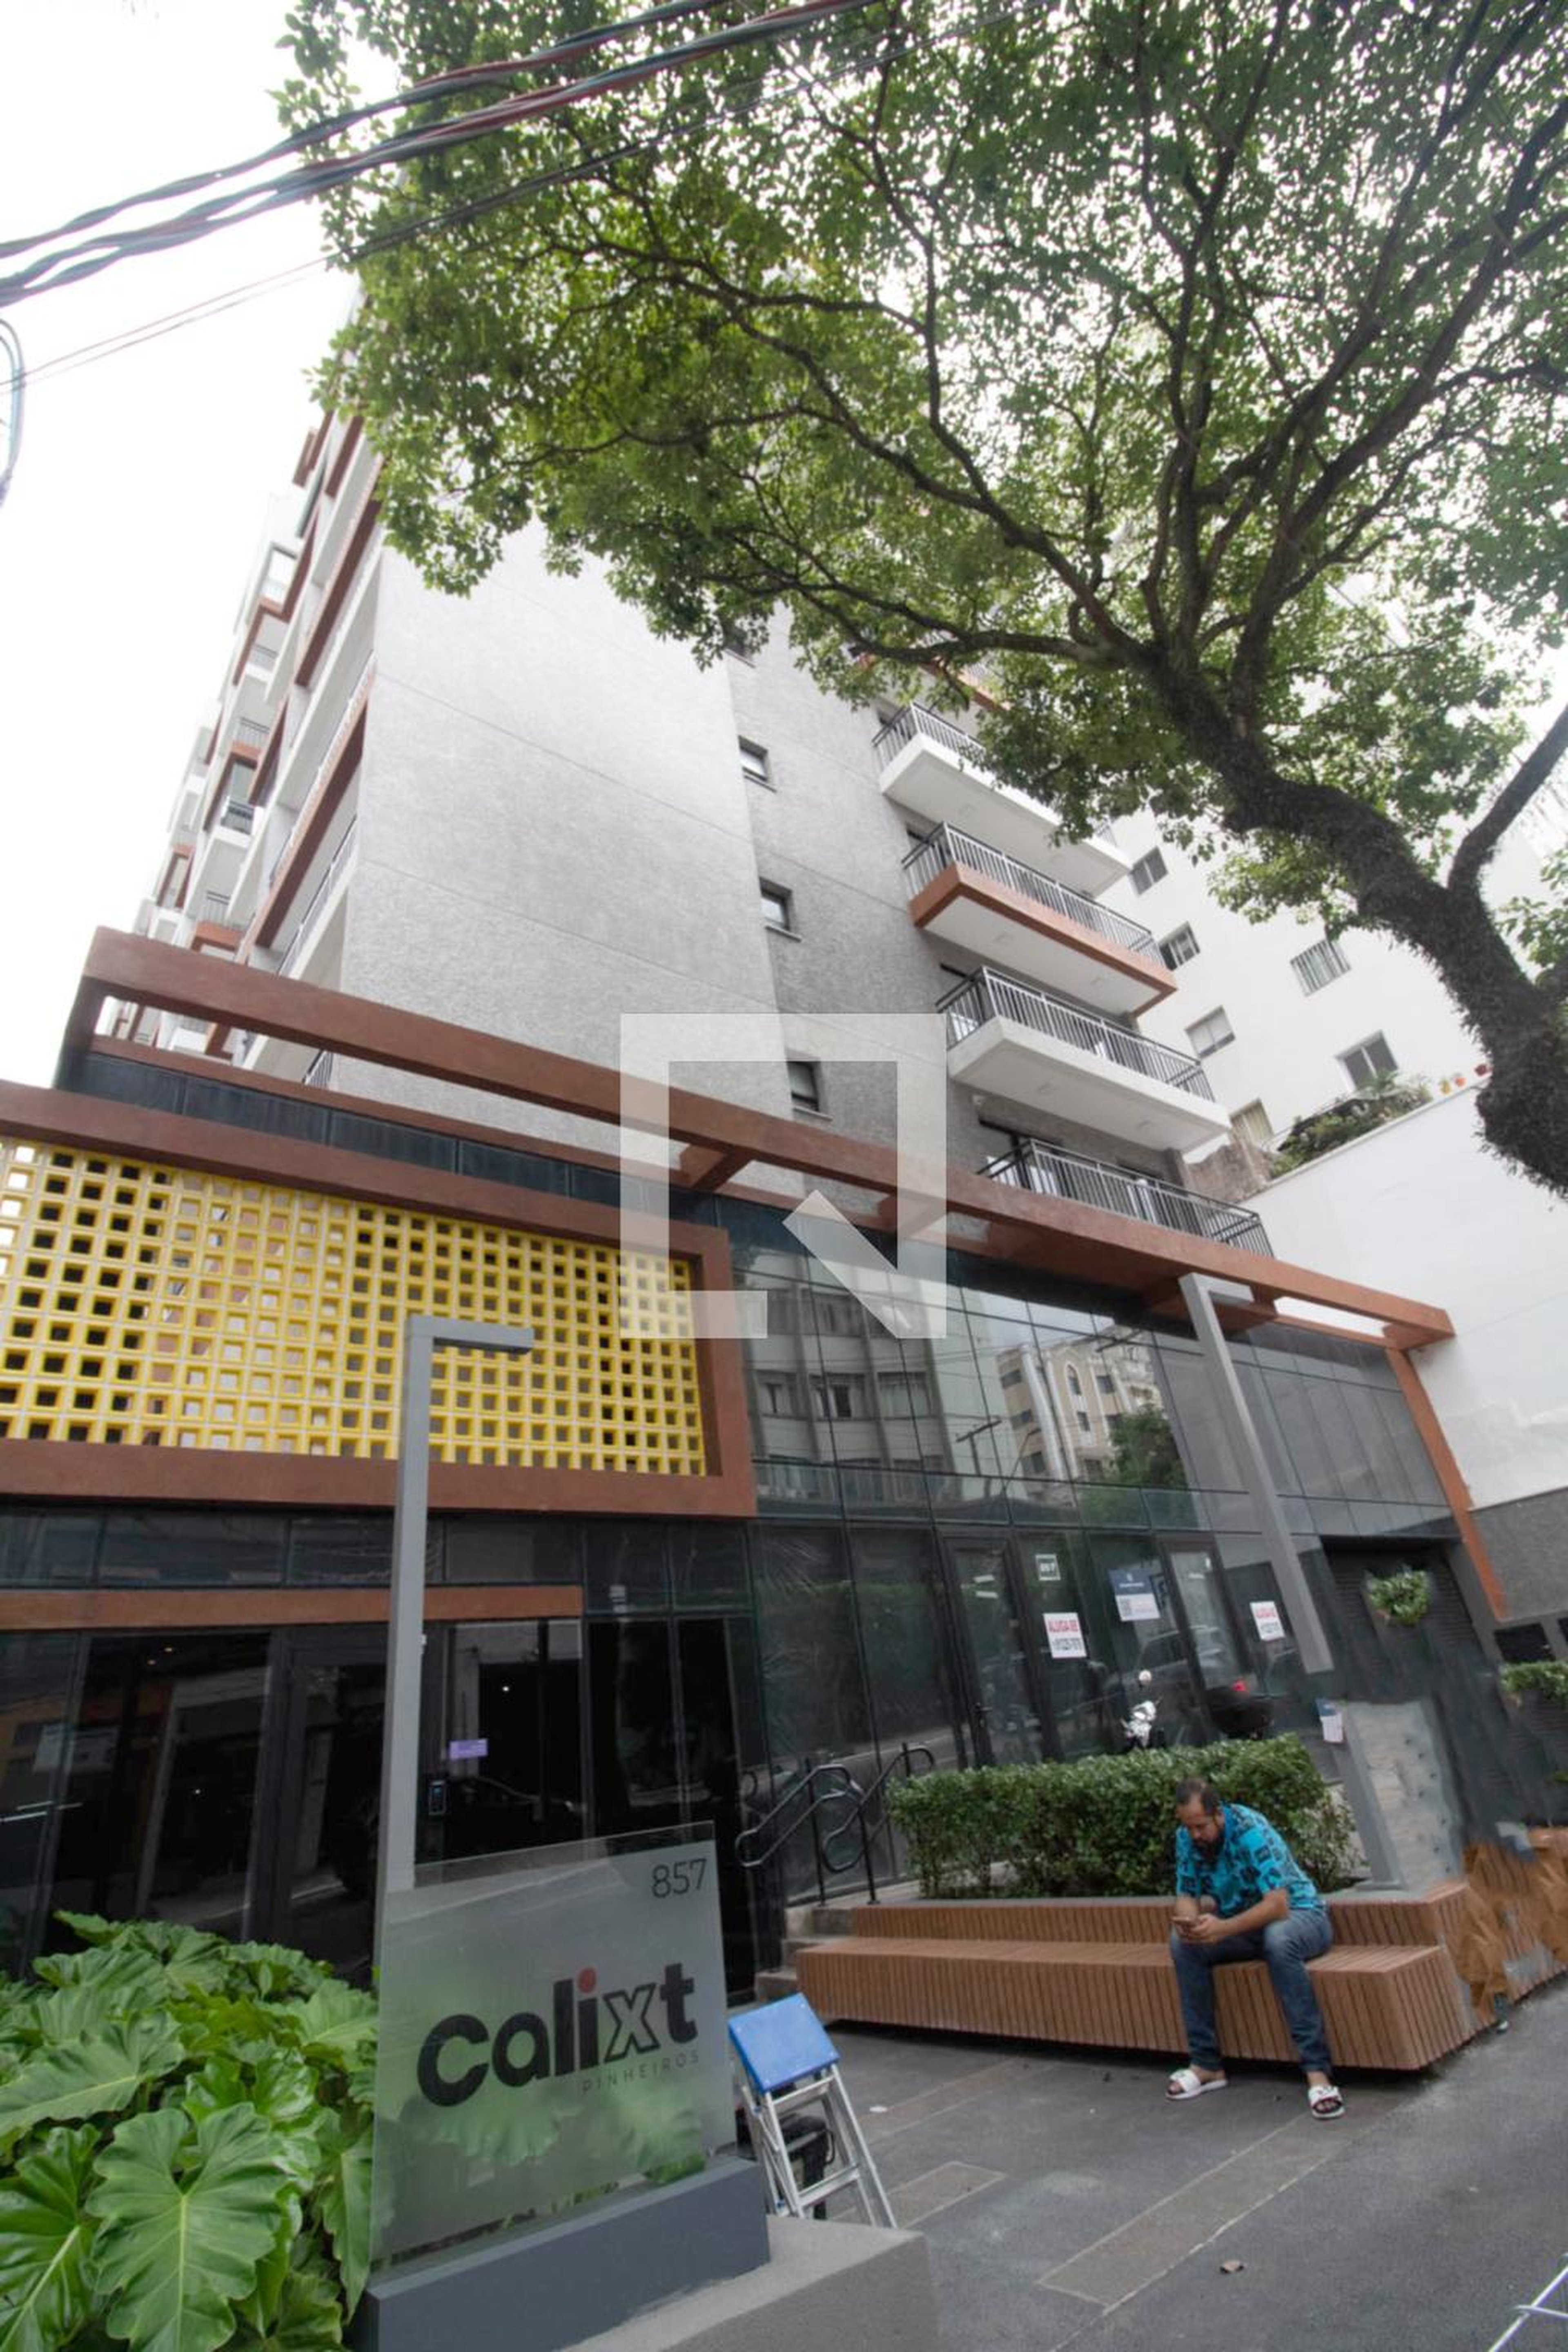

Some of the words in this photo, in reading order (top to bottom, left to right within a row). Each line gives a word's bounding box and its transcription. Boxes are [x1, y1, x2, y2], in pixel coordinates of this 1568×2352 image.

[652, 1858, 706, 1898] 857
[417, 1962, 698, 2107] calixt
[581, 2049, 699, 2095] PINHEIROS
